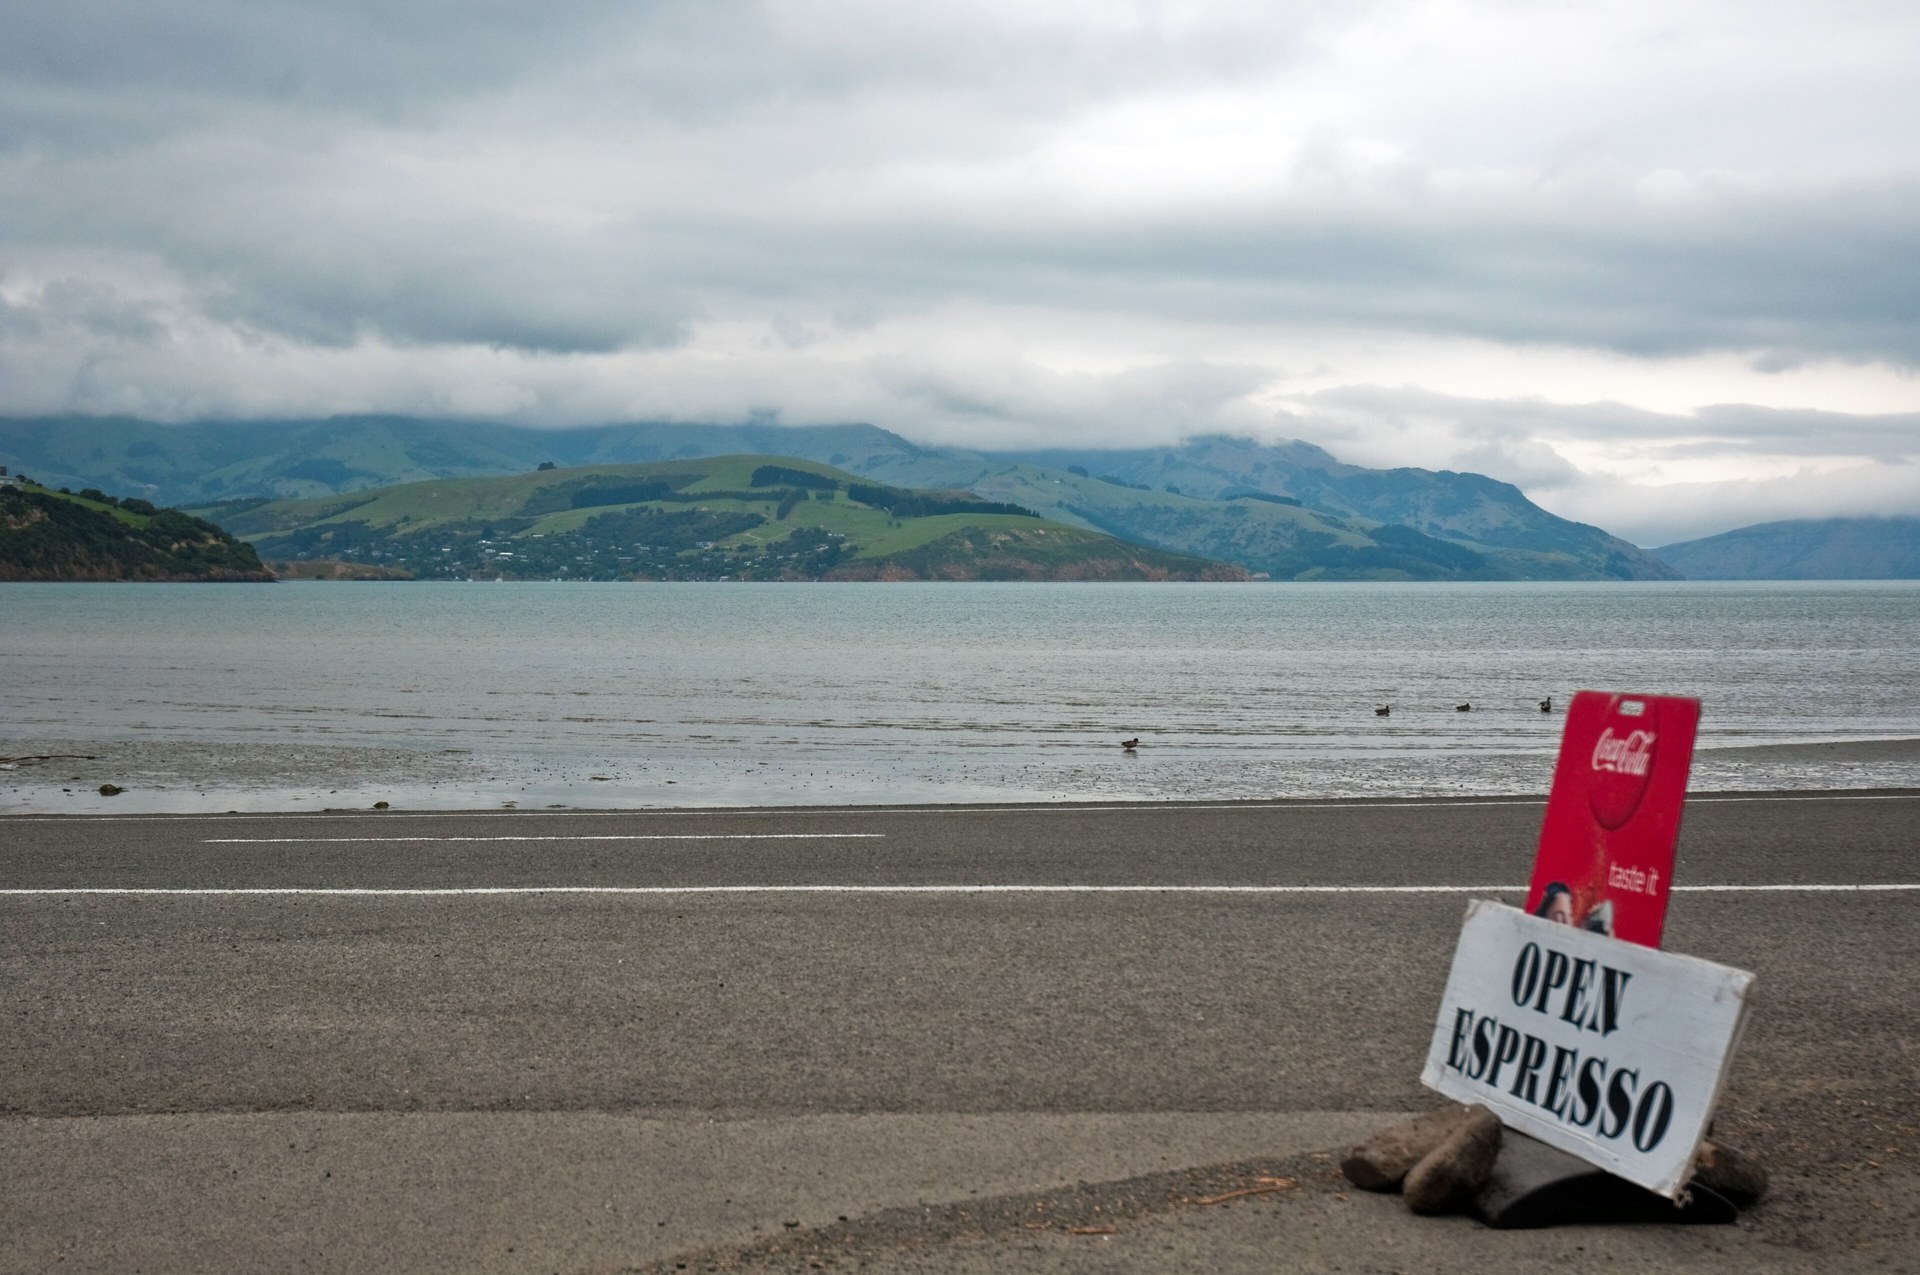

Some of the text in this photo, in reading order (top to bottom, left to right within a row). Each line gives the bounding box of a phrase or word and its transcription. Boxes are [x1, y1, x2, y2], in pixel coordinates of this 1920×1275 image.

[1608, 861, 1660, 896] taste it
[1511, 941, 1633, 1038] OPEN
[1445, 1006, 1675, 1154] ESPRESSO
